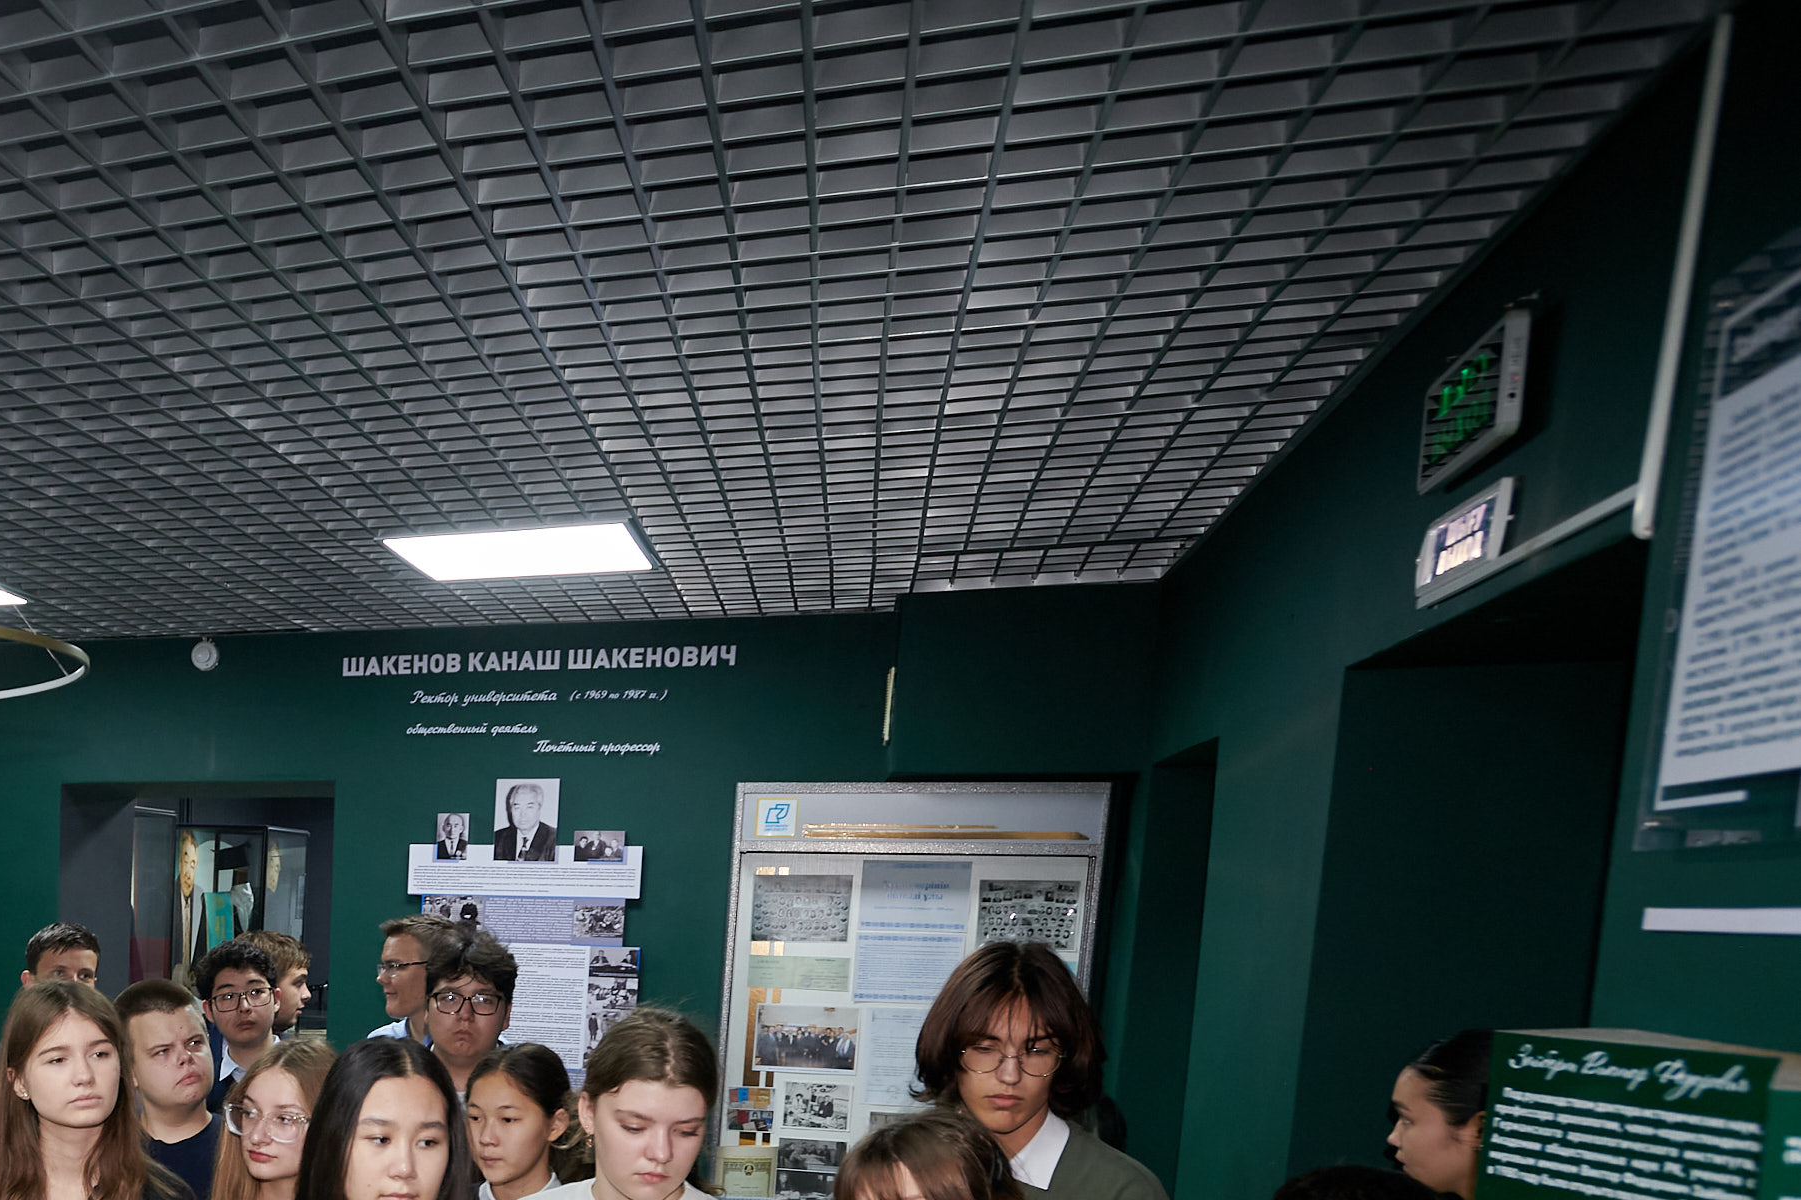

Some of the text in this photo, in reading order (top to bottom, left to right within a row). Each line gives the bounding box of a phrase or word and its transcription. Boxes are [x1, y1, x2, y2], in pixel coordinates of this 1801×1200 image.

[342, 645, 737, 677] ШАКЕНОВ КАНАШ ШАКЕНОВИЧ
[409, 690, 459, 707] Ректор
[461, 689, 558, 707] университета
[583, 689, 608, 700] 1969
[608, 692, 620, 700] по
[622, 689, 647, 699] 1987
[405, 722, 539, 737] общественный деятель
[532, 740, 661, 756] Почётный профессор
